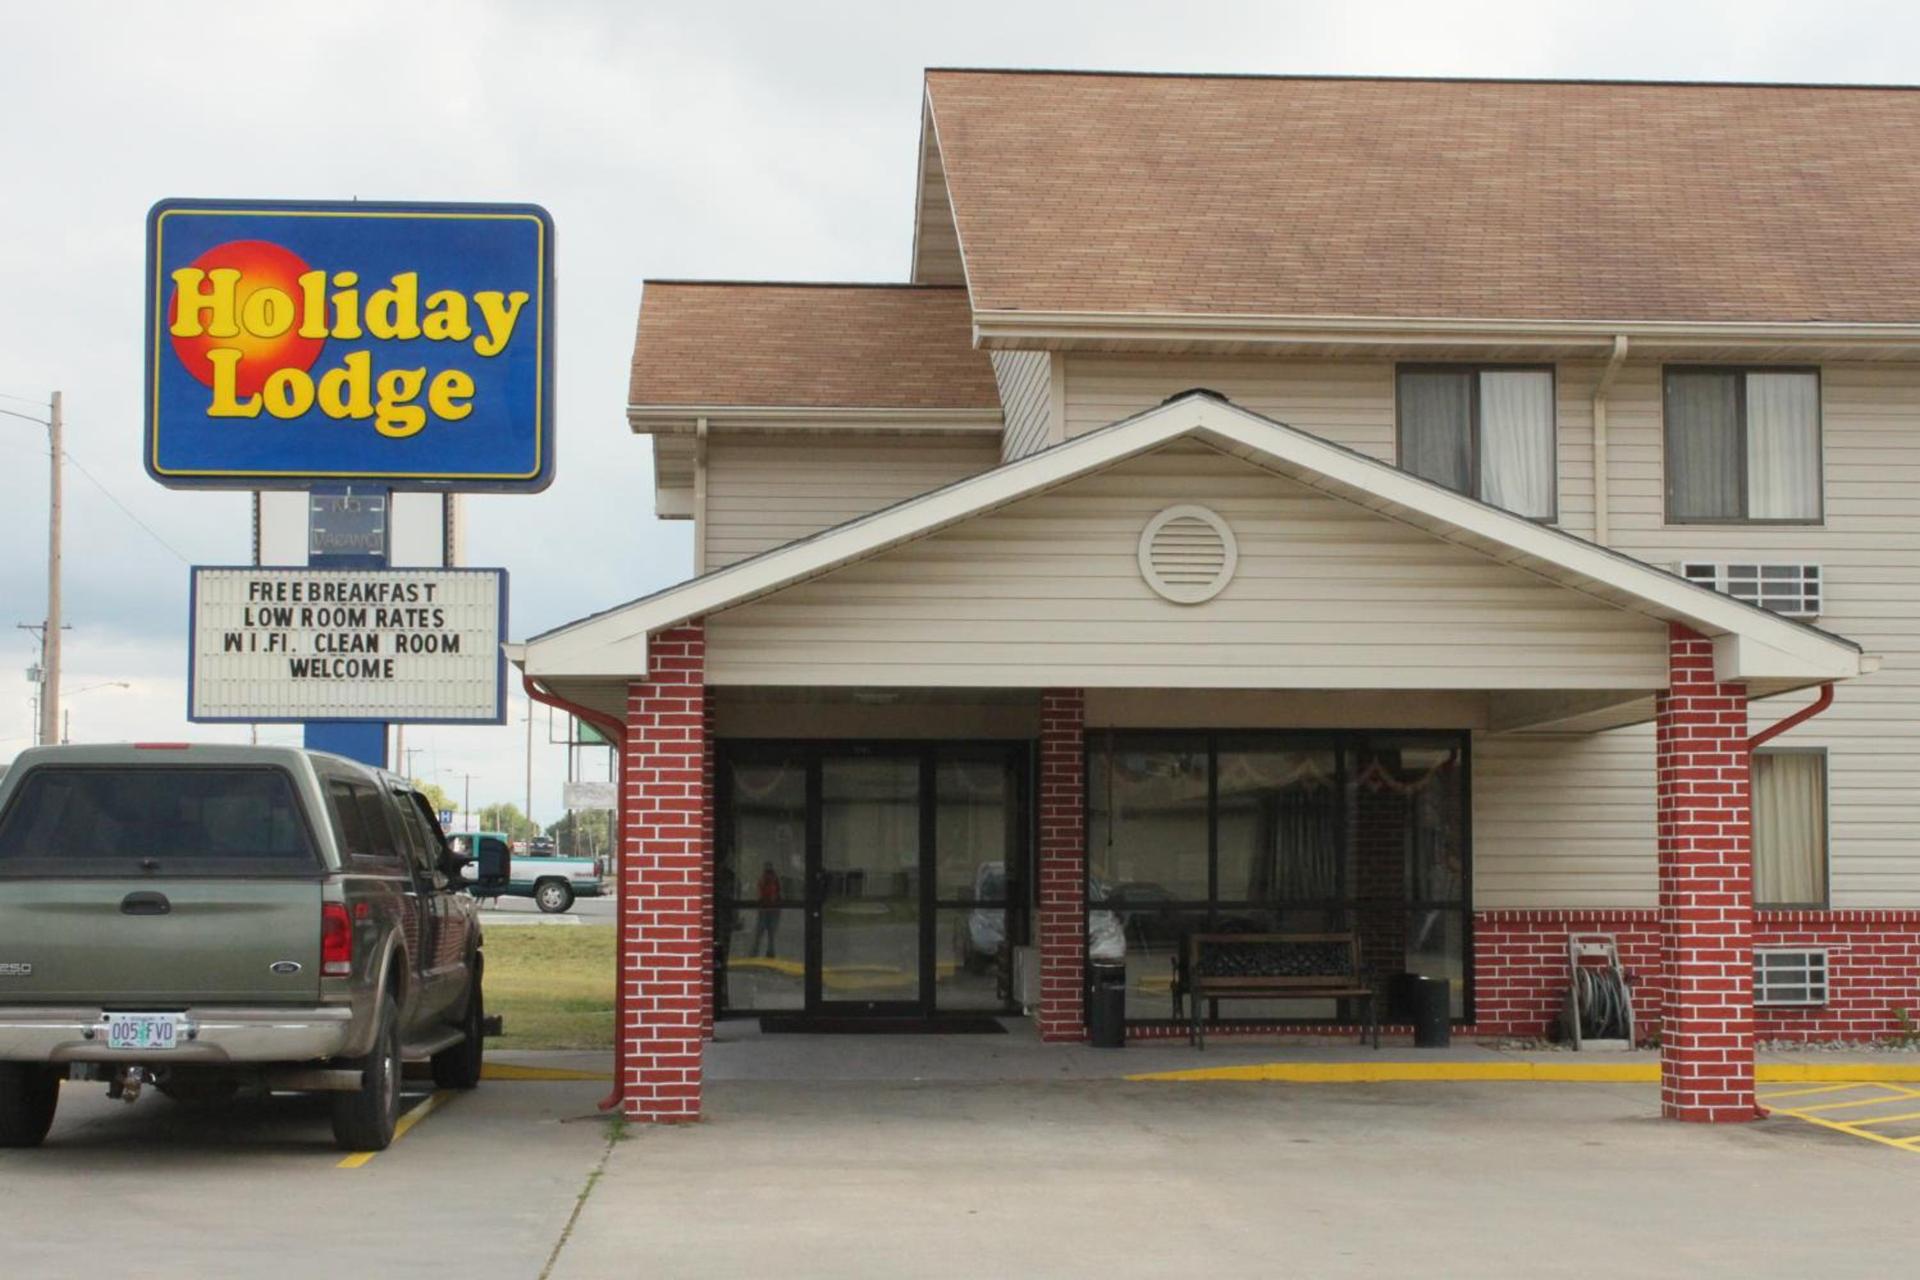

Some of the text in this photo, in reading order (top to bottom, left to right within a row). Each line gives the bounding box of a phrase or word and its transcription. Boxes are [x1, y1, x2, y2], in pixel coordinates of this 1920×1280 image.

[169, 268, 530, 357] Holiday
[206, 347, 475, 438] Lodge
[244, 607, 445, 628] LOW ROOM RATES
[314, 633, 379, 653] CLEAN
[395, 634, 460, 653] ROOM
[290, 658, 394, 678] WELCOME
